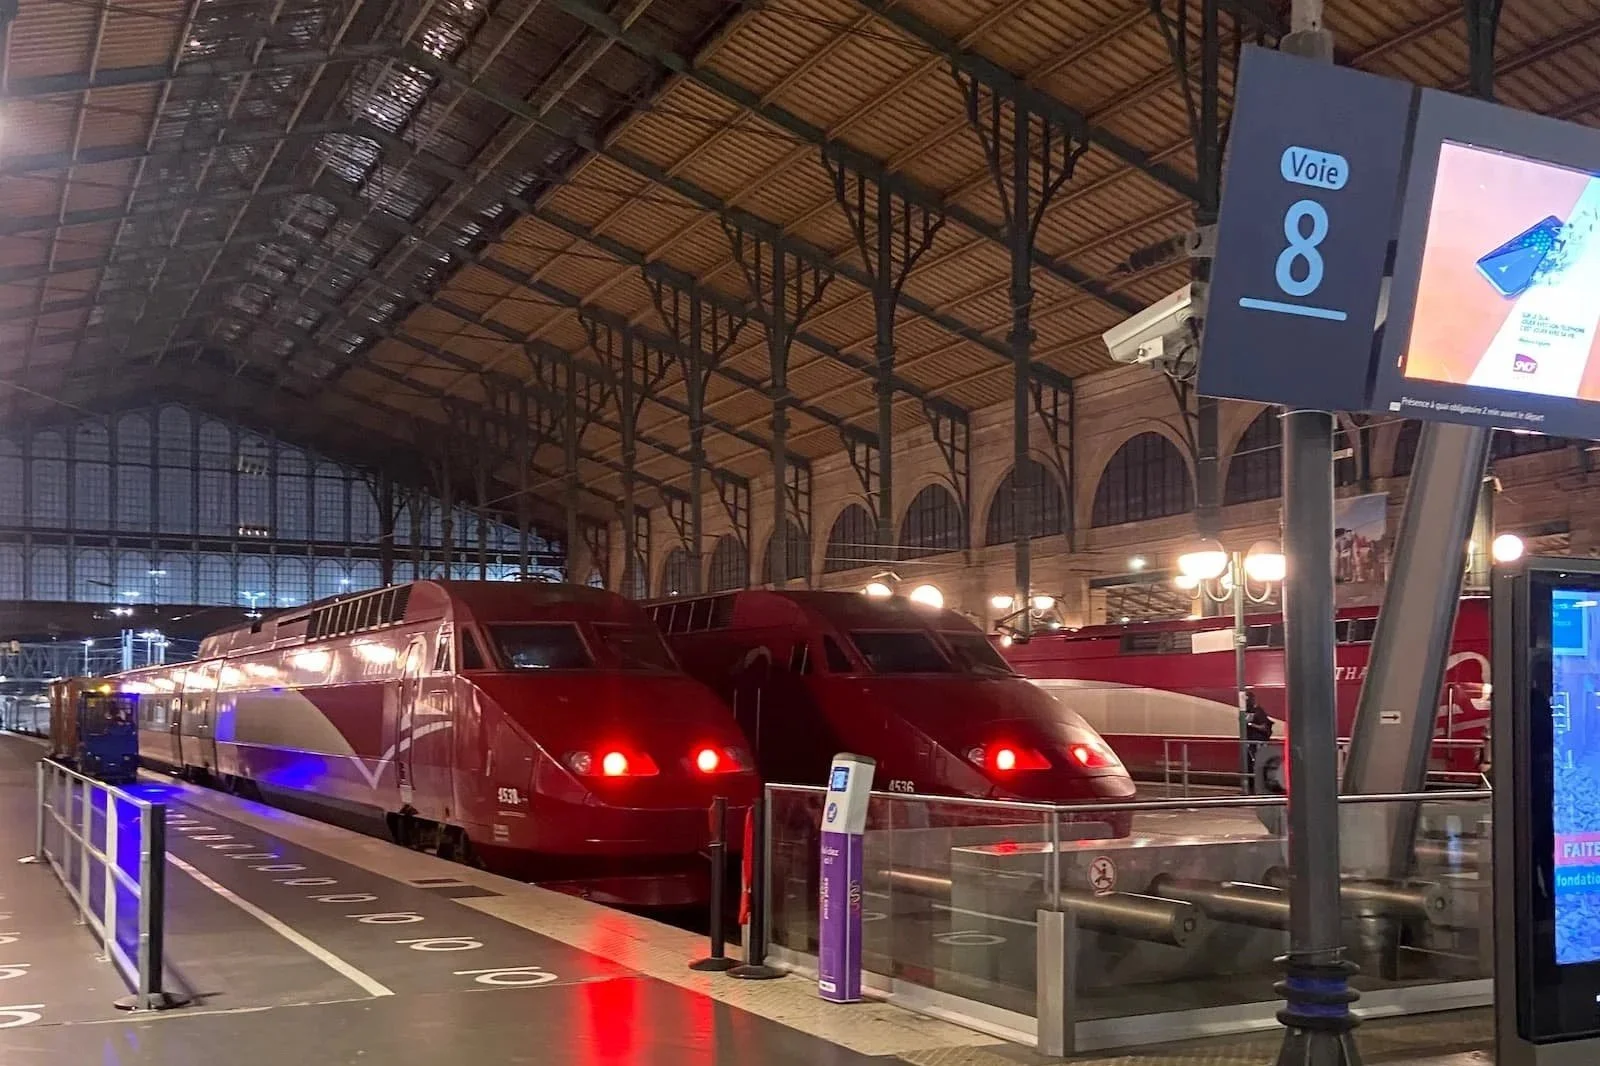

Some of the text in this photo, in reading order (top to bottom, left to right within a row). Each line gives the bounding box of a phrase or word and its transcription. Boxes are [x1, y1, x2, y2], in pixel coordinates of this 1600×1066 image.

[1291, 151, 1339, 185] Voie
[1275, 199, 1329, 297] 8
[889, 779, 915, 793] 4536
